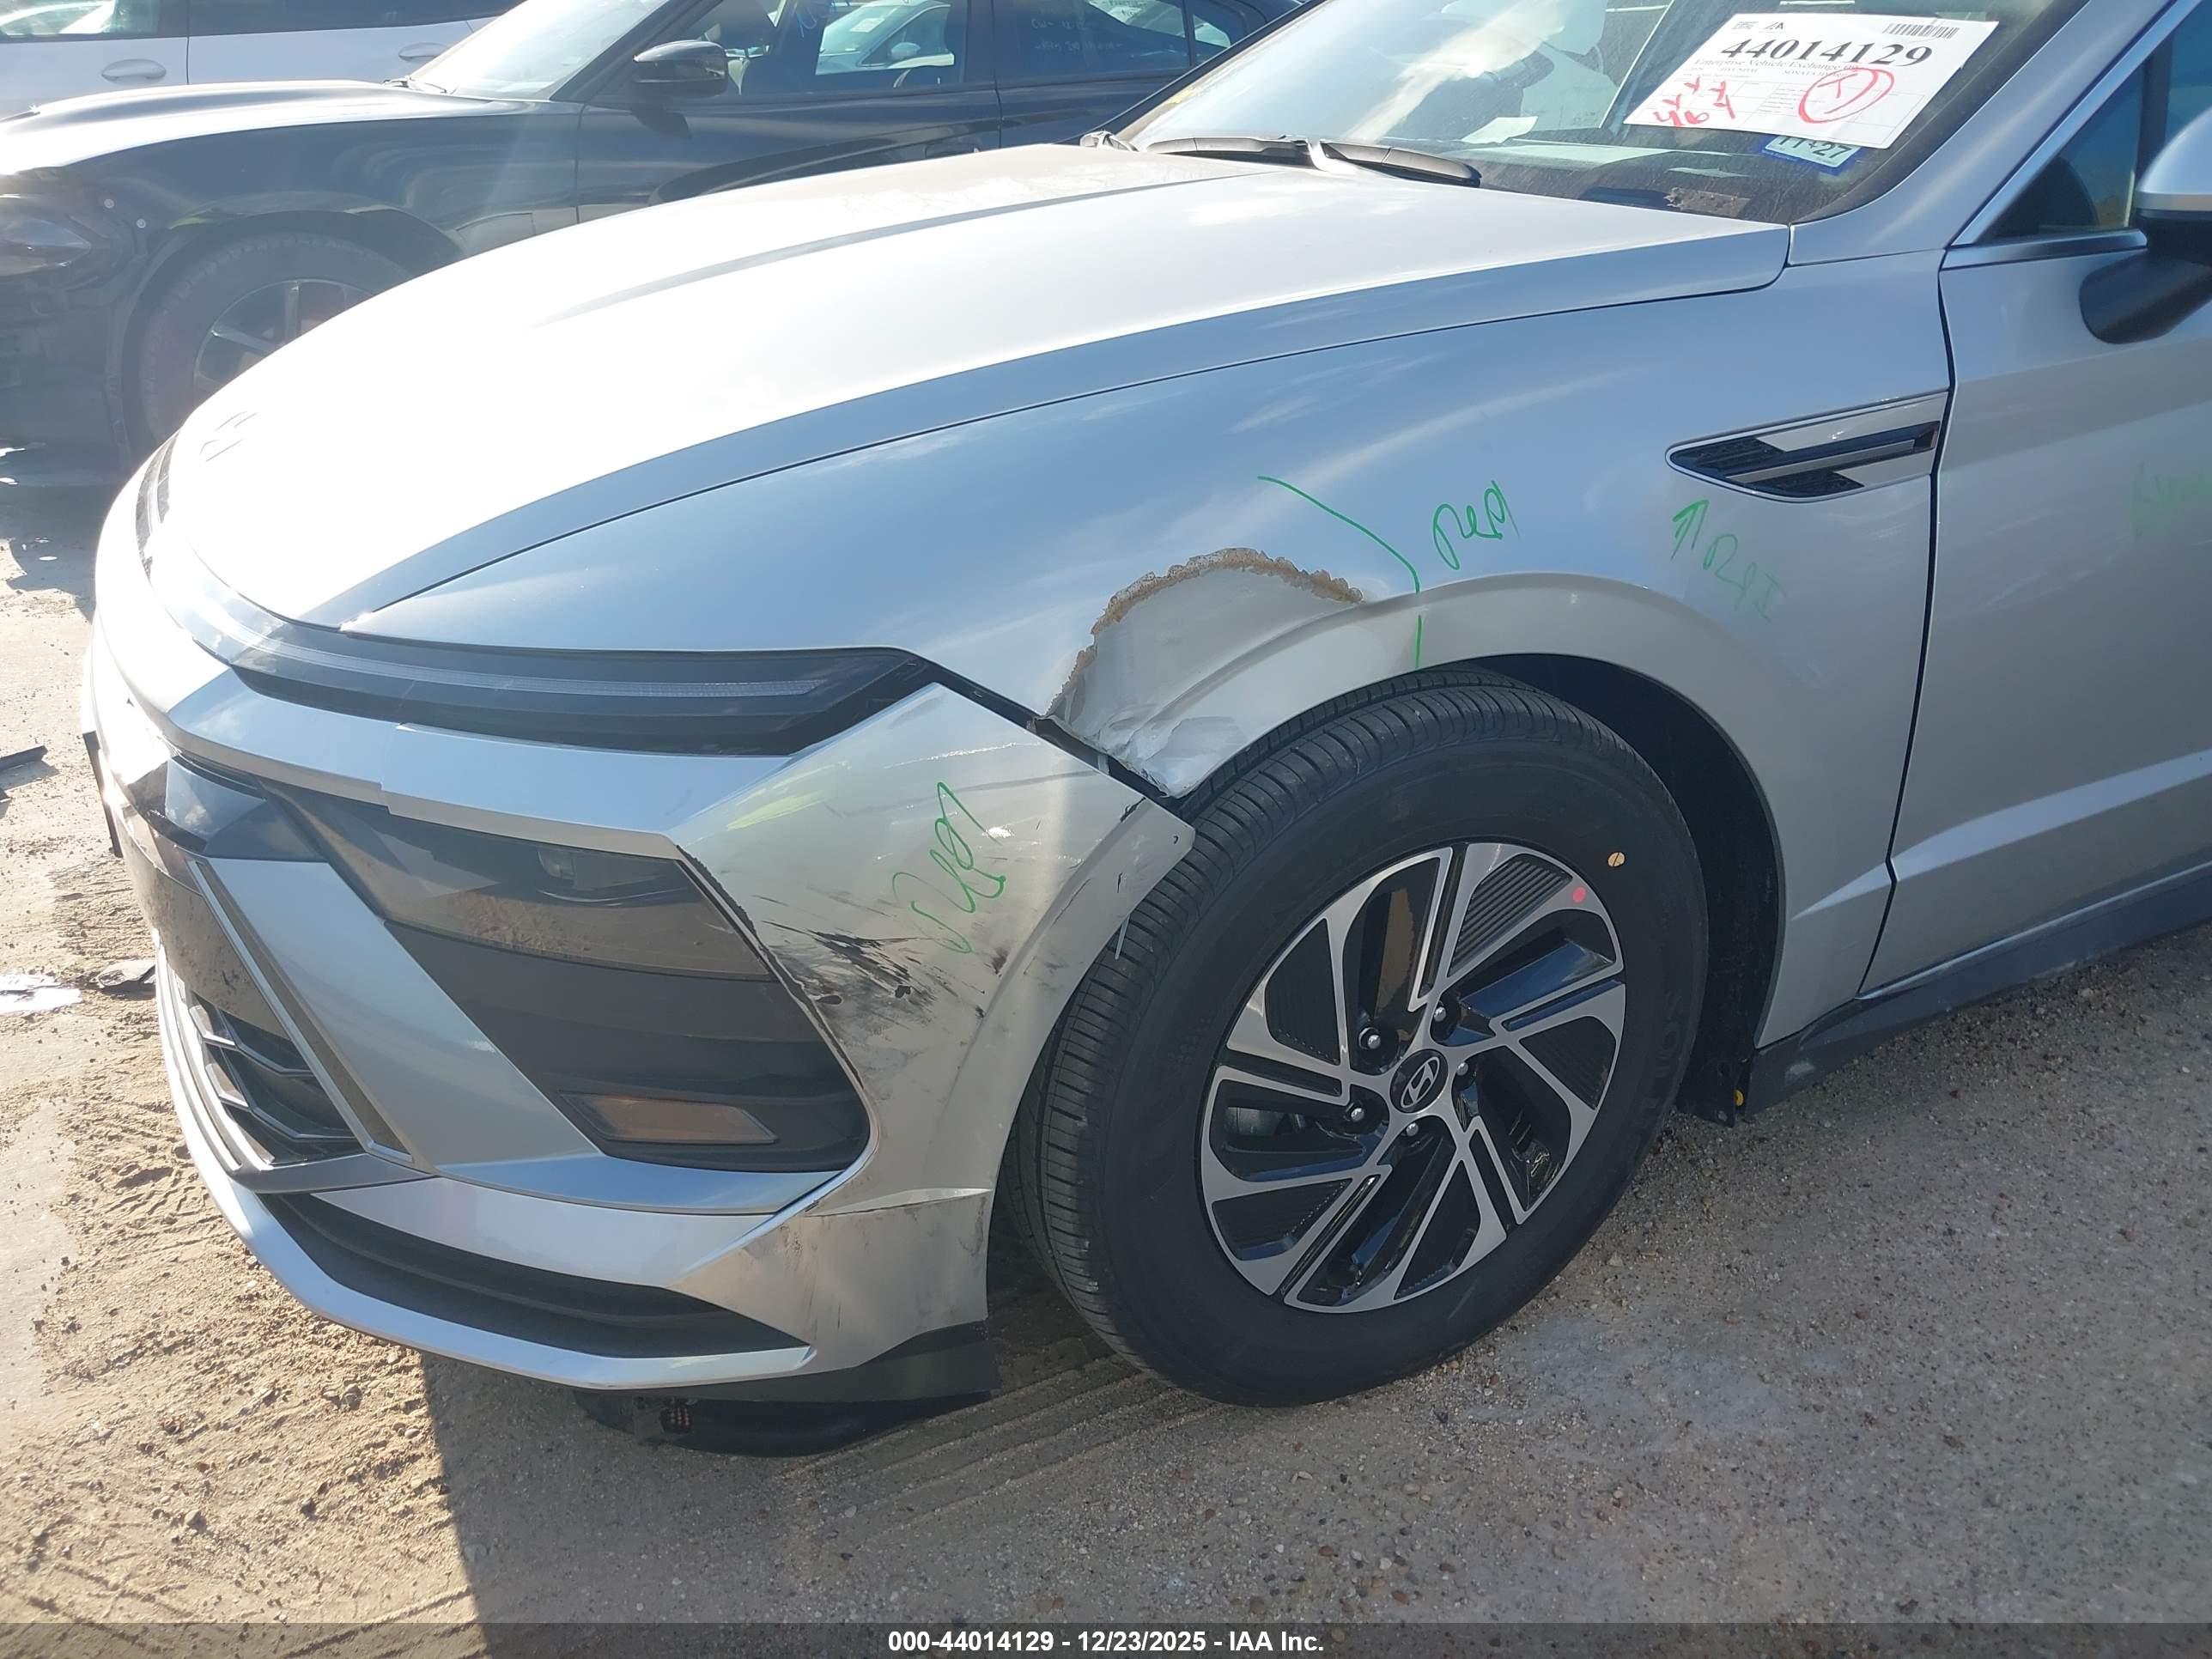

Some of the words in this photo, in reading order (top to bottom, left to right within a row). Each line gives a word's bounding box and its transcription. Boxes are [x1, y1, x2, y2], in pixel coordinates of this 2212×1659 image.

[1721, 38, 1933, 67] 44014129
[1749, 59, 1787, 68] Vehicle
[1789, 61, 1841, 70] Exchange
